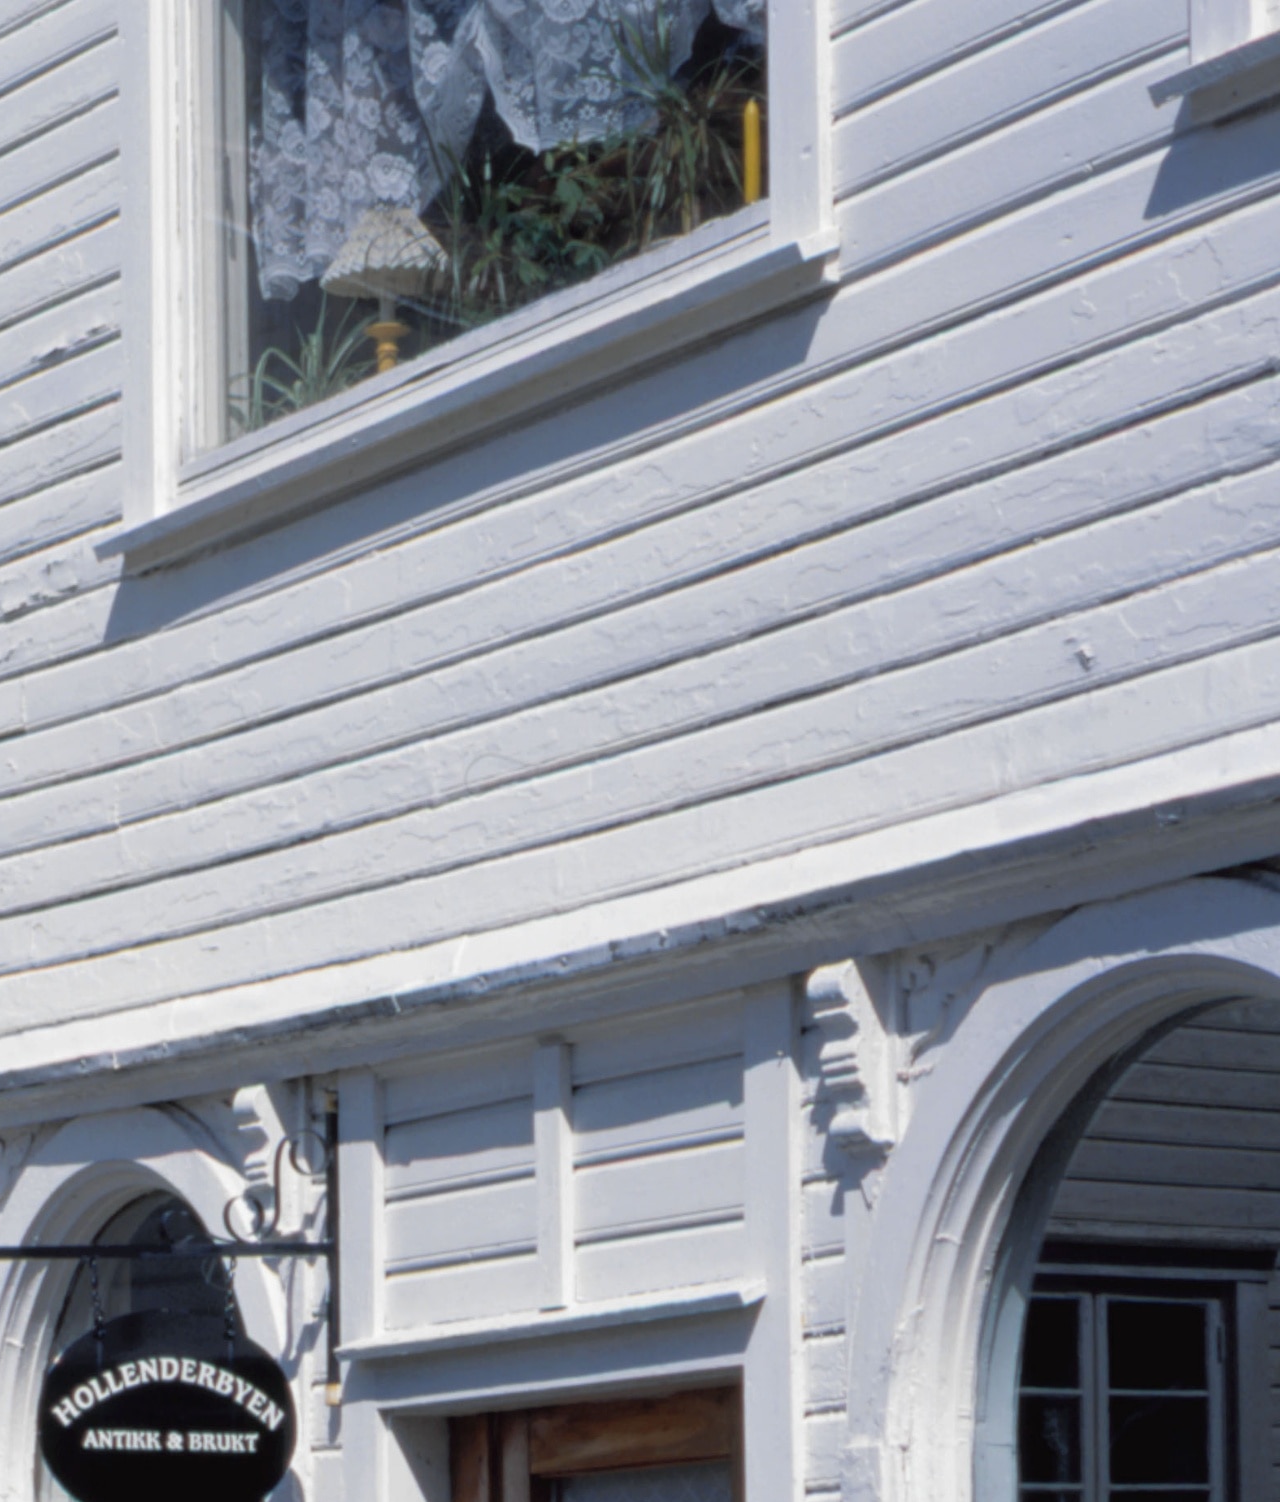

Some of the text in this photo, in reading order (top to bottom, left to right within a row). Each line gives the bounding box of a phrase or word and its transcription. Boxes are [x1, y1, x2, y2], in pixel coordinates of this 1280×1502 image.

[51, 1356, 285, 1432] HOLLENDERBYEN
[82, 1430, 259, 1453] ANTIKK & BRUKT
